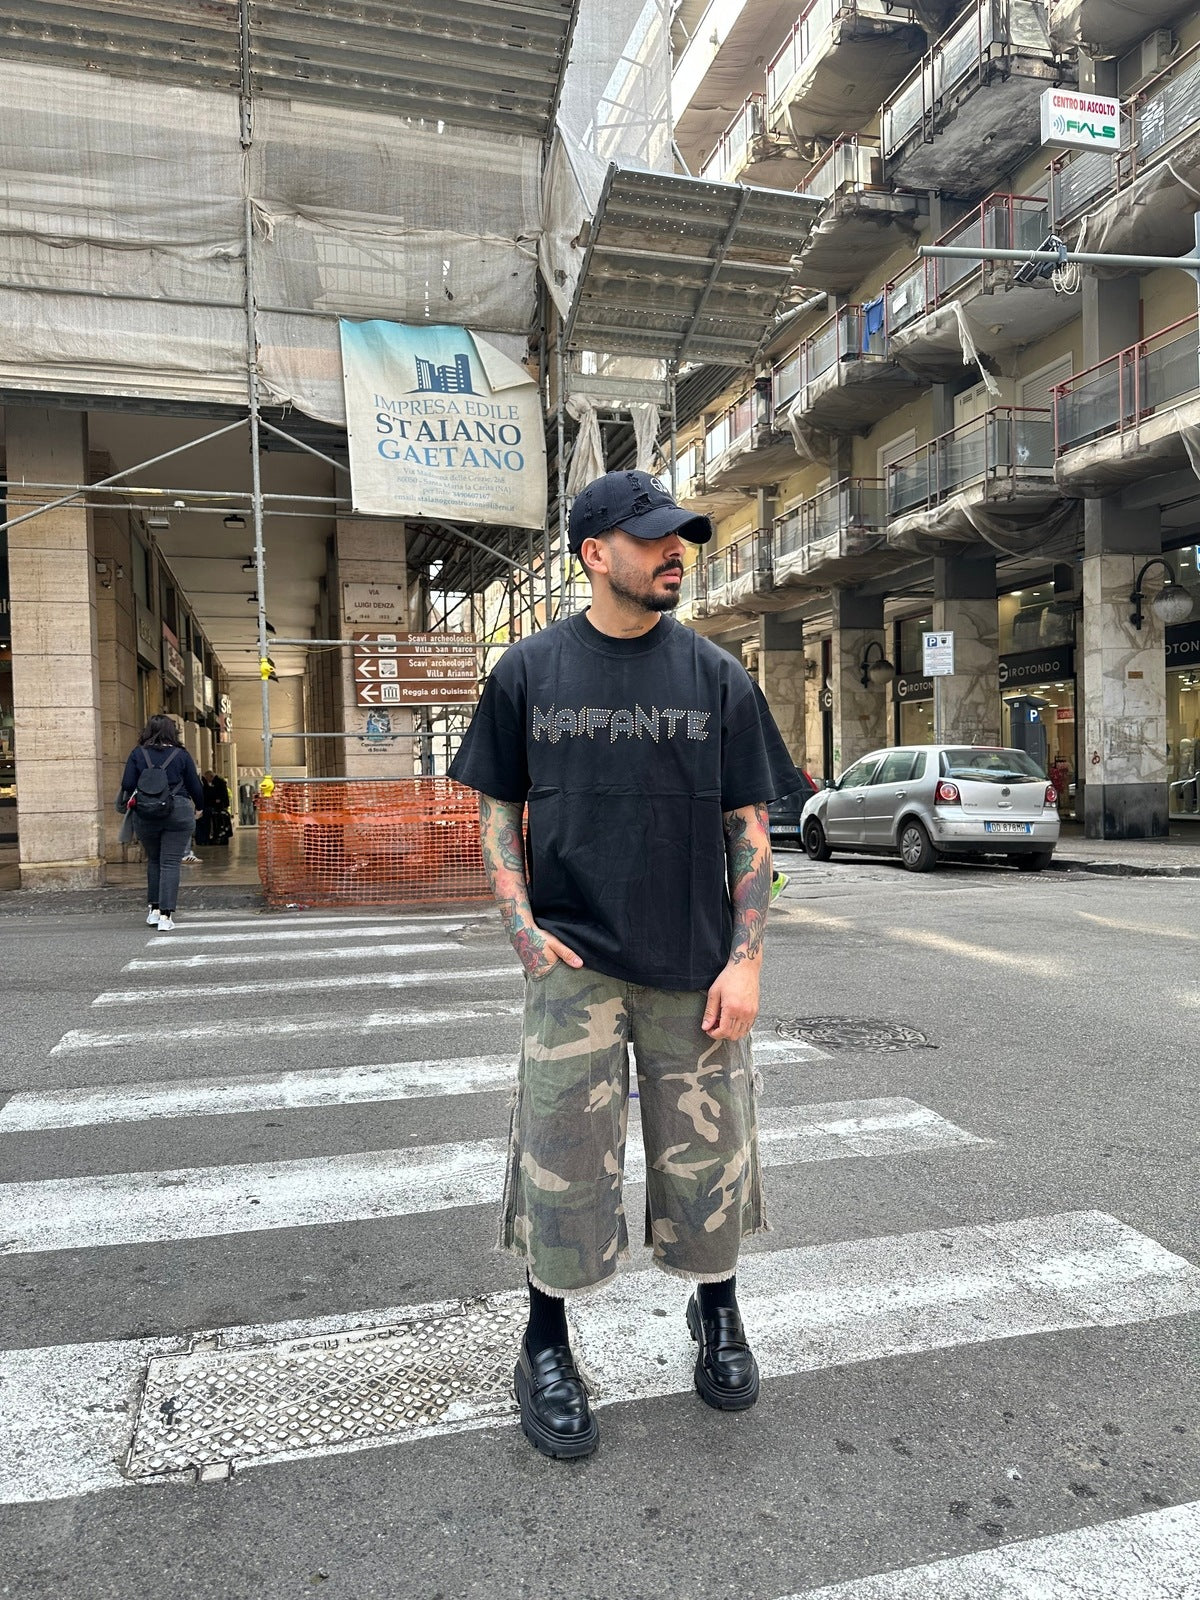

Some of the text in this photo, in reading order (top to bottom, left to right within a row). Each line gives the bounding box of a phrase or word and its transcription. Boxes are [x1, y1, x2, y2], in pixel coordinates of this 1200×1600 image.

[1052, 95, 1116, 117] CENTRO DI ASCOLTO
[374, 393, 520, 421] IMPRESA EDILE
[376, 412, 521, 446] STAIANO
[377, 439, 525, 472] GAETANO
[407, 634, 427, 642] Scavi
[408, 659, 474, 668] Scavi archeologici
[426, 669, 474, 678] Villa Arianna
[998, 661, 1060, 683] GIROTONDO
[402, 688, 429, 696] Reggia
[440, 688, 477, 696] Quisisana
[532, 703, 711, 744] MAIFANTE
